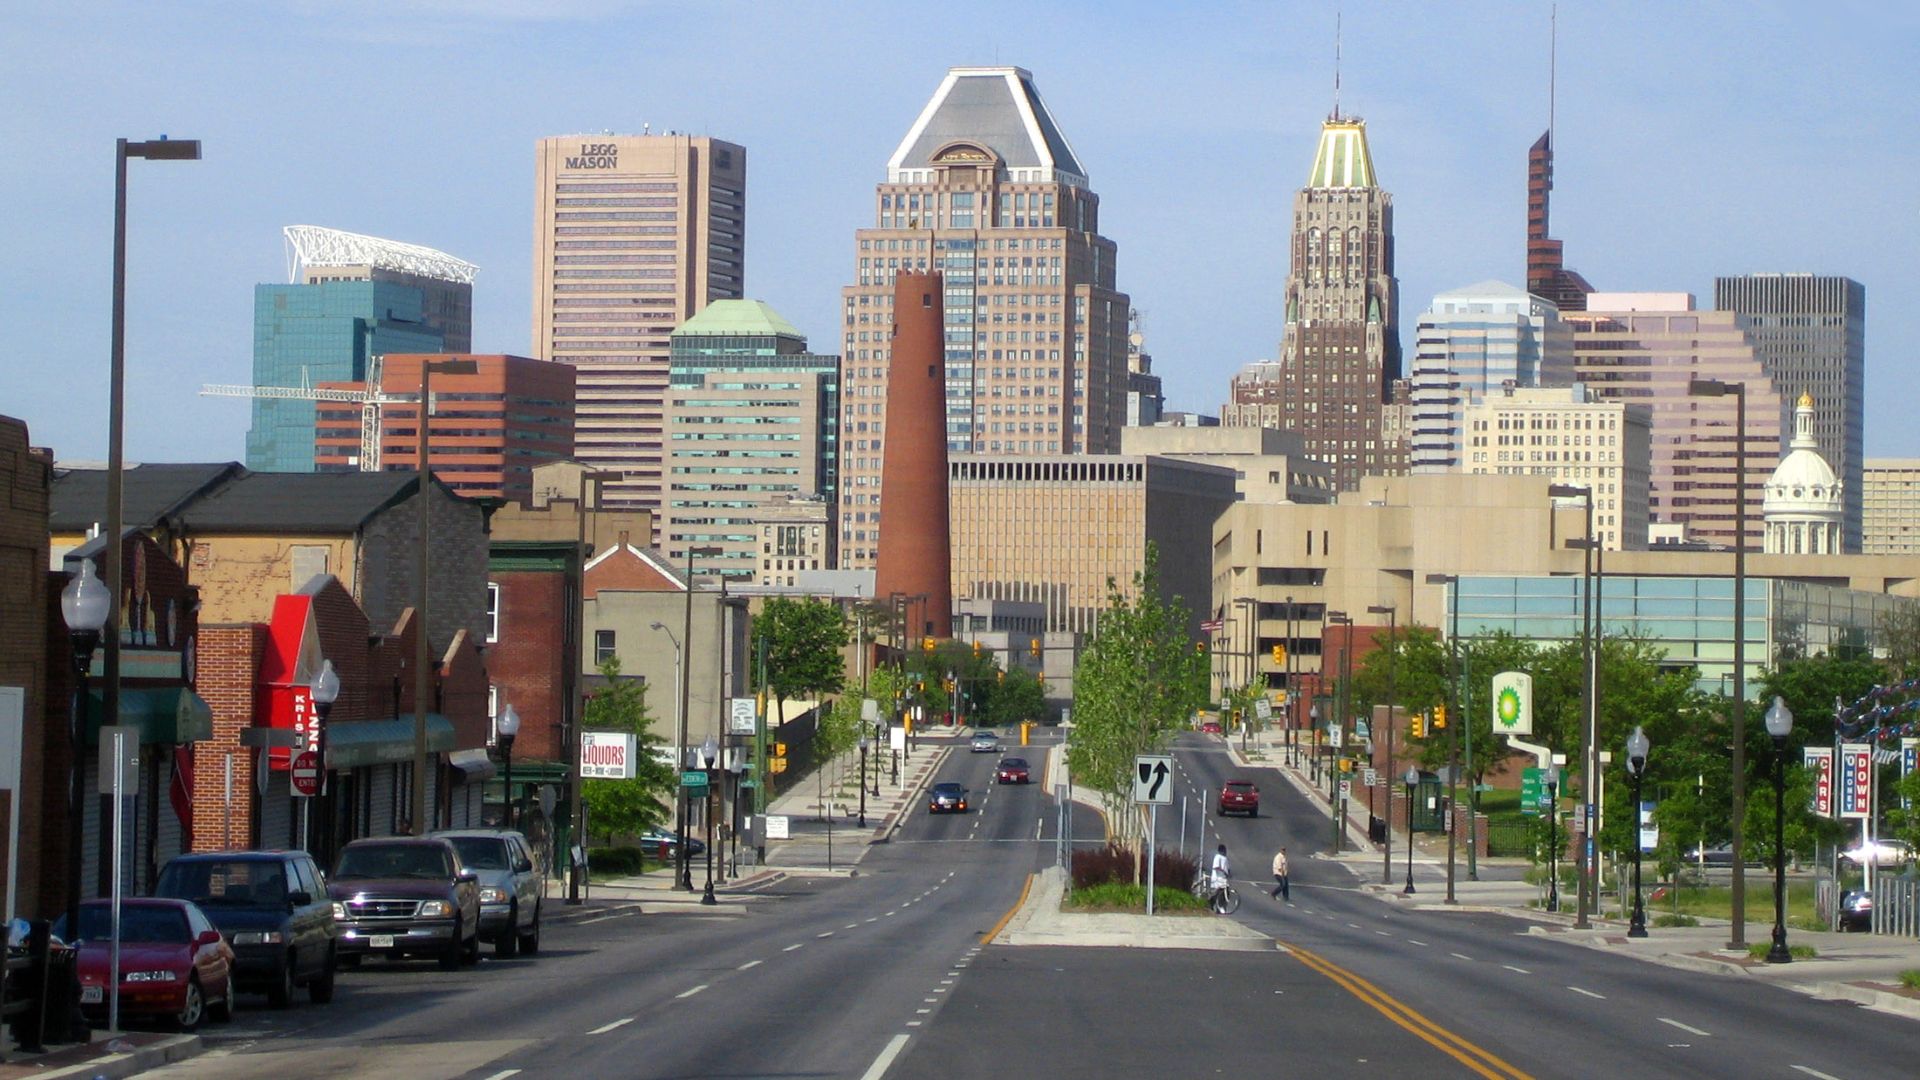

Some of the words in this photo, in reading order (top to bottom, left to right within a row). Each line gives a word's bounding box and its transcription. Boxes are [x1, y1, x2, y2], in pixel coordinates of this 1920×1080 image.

[581, 144, 618, 156] LEGG
[565, 157, 618, 169] MASON
[583, 745, 624, 766] LIQUORS
[1820, 759, 1828, 811] CARS
[1857, 758, 1867, 809] DOWN
